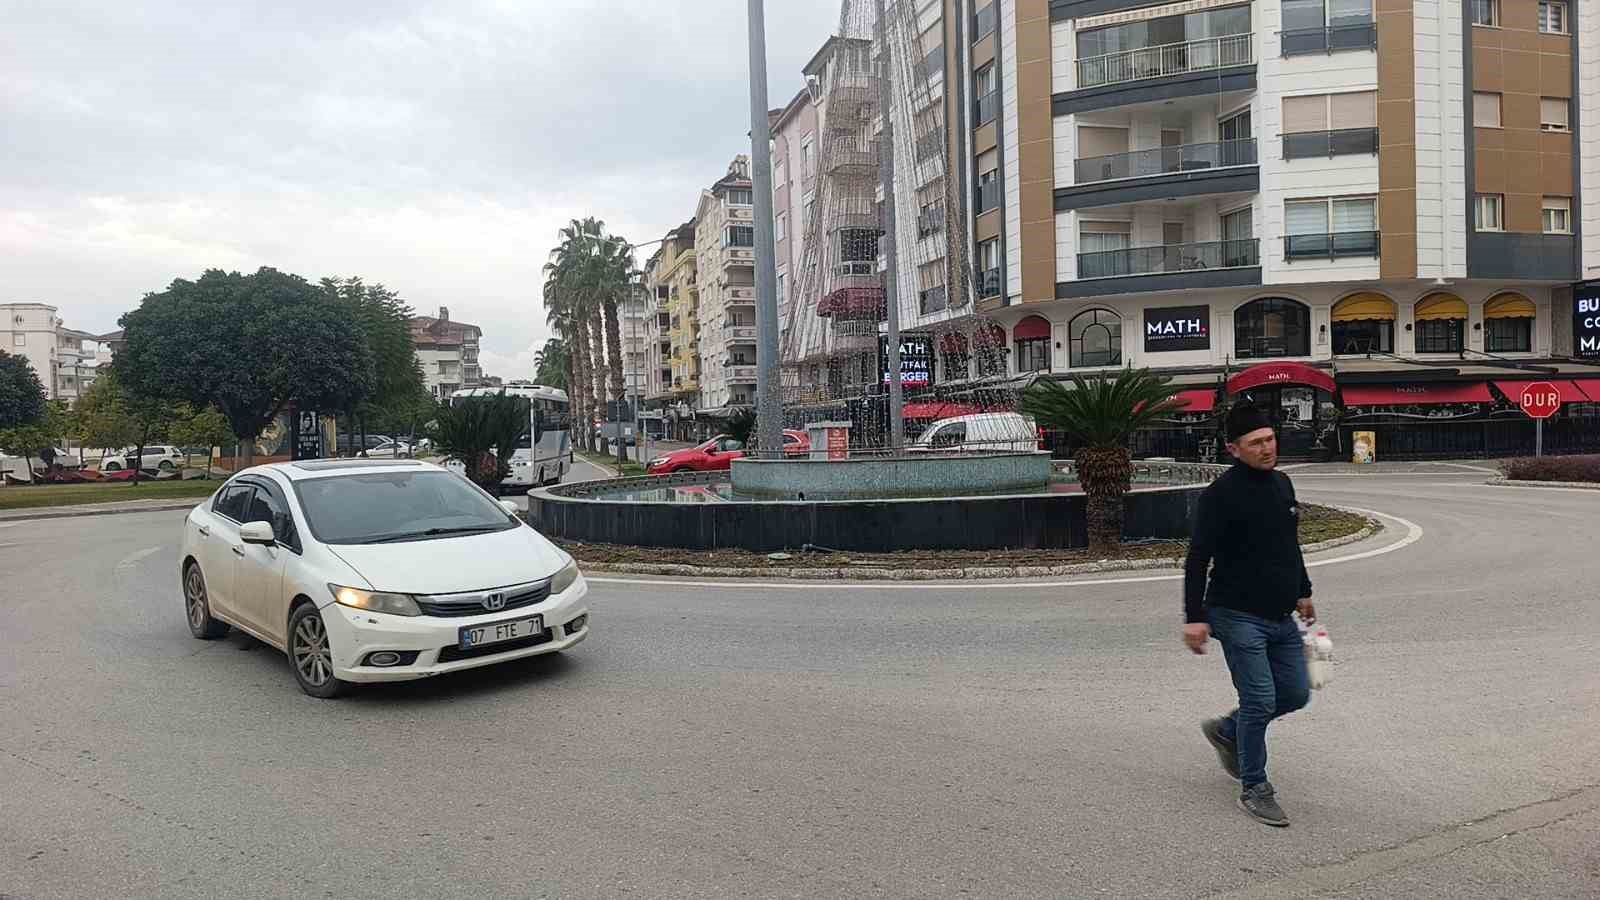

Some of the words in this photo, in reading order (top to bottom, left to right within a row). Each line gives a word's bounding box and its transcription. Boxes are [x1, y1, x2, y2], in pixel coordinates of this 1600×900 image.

[1523, 393, 1557, 407] DUR
[470, 629, 485, 644] 07
[496, 623, 518, 640] FTE
[528, 619, 541, 634] 71
